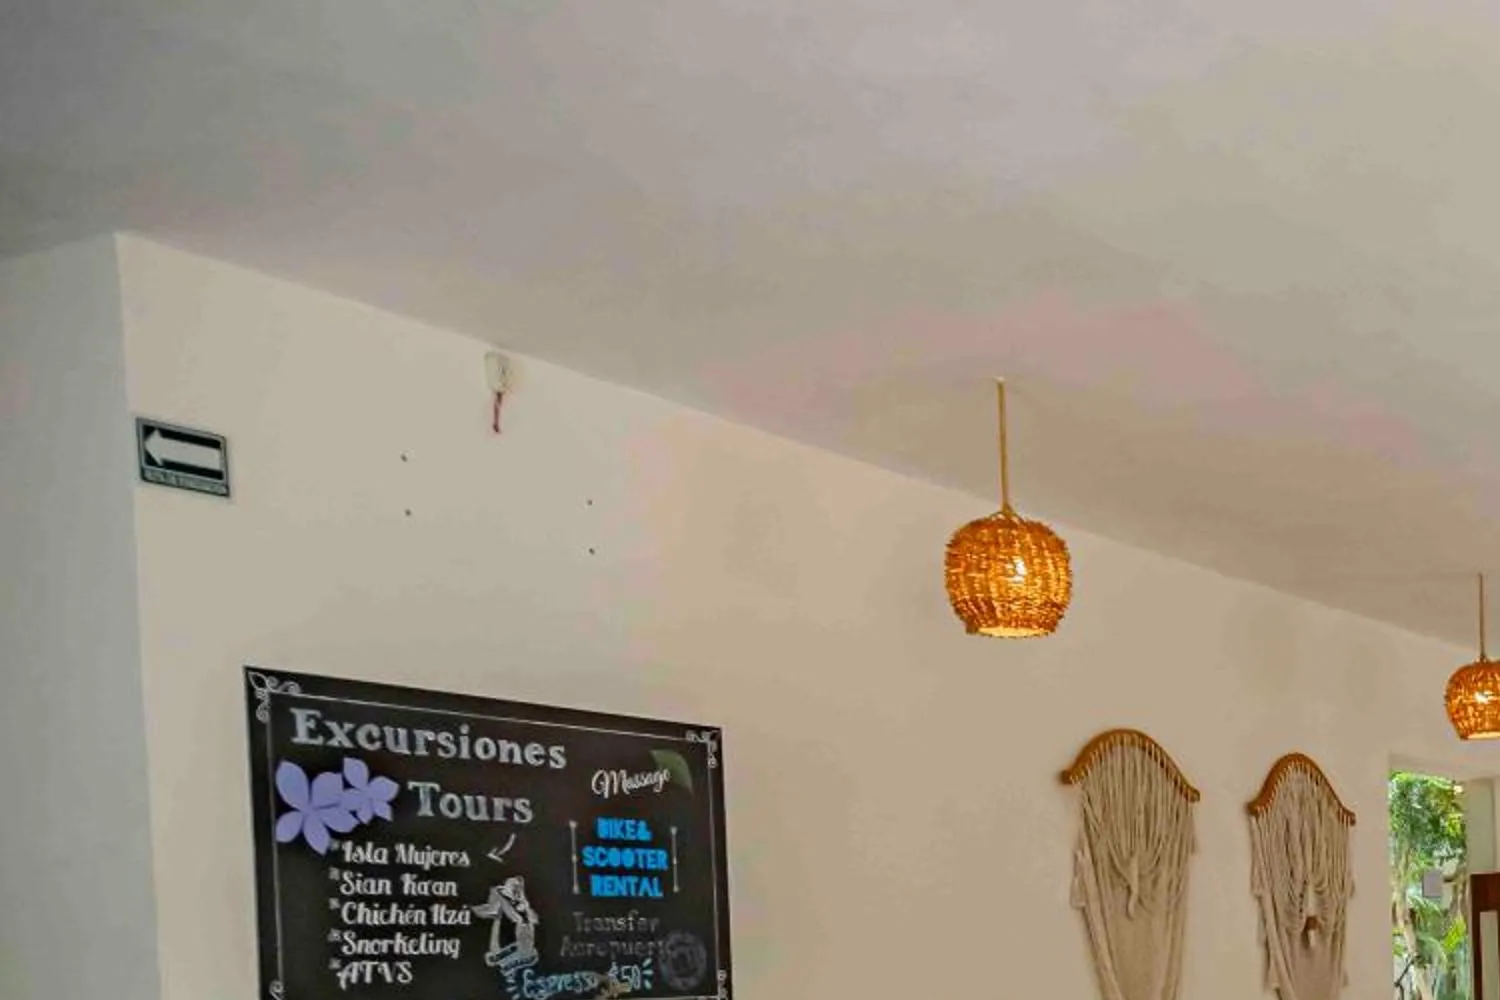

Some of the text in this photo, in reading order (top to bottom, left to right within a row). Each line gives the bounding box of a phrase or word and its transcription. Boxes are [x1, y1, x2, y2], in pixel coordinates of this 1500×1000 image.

[290, 707, 567, 769] Excursiones
[591, 768, 671, 799] Massage
[407, 780, 533, 823] Tours
[342, 840, 471, 871] Isla Mujeres
[582, 845, 669, 871] SCOOTER
[340, 870, 392, 895] Sian
[590, 874, 664, 897] RENTAL
[572, 909, 660, 933] Transfer
